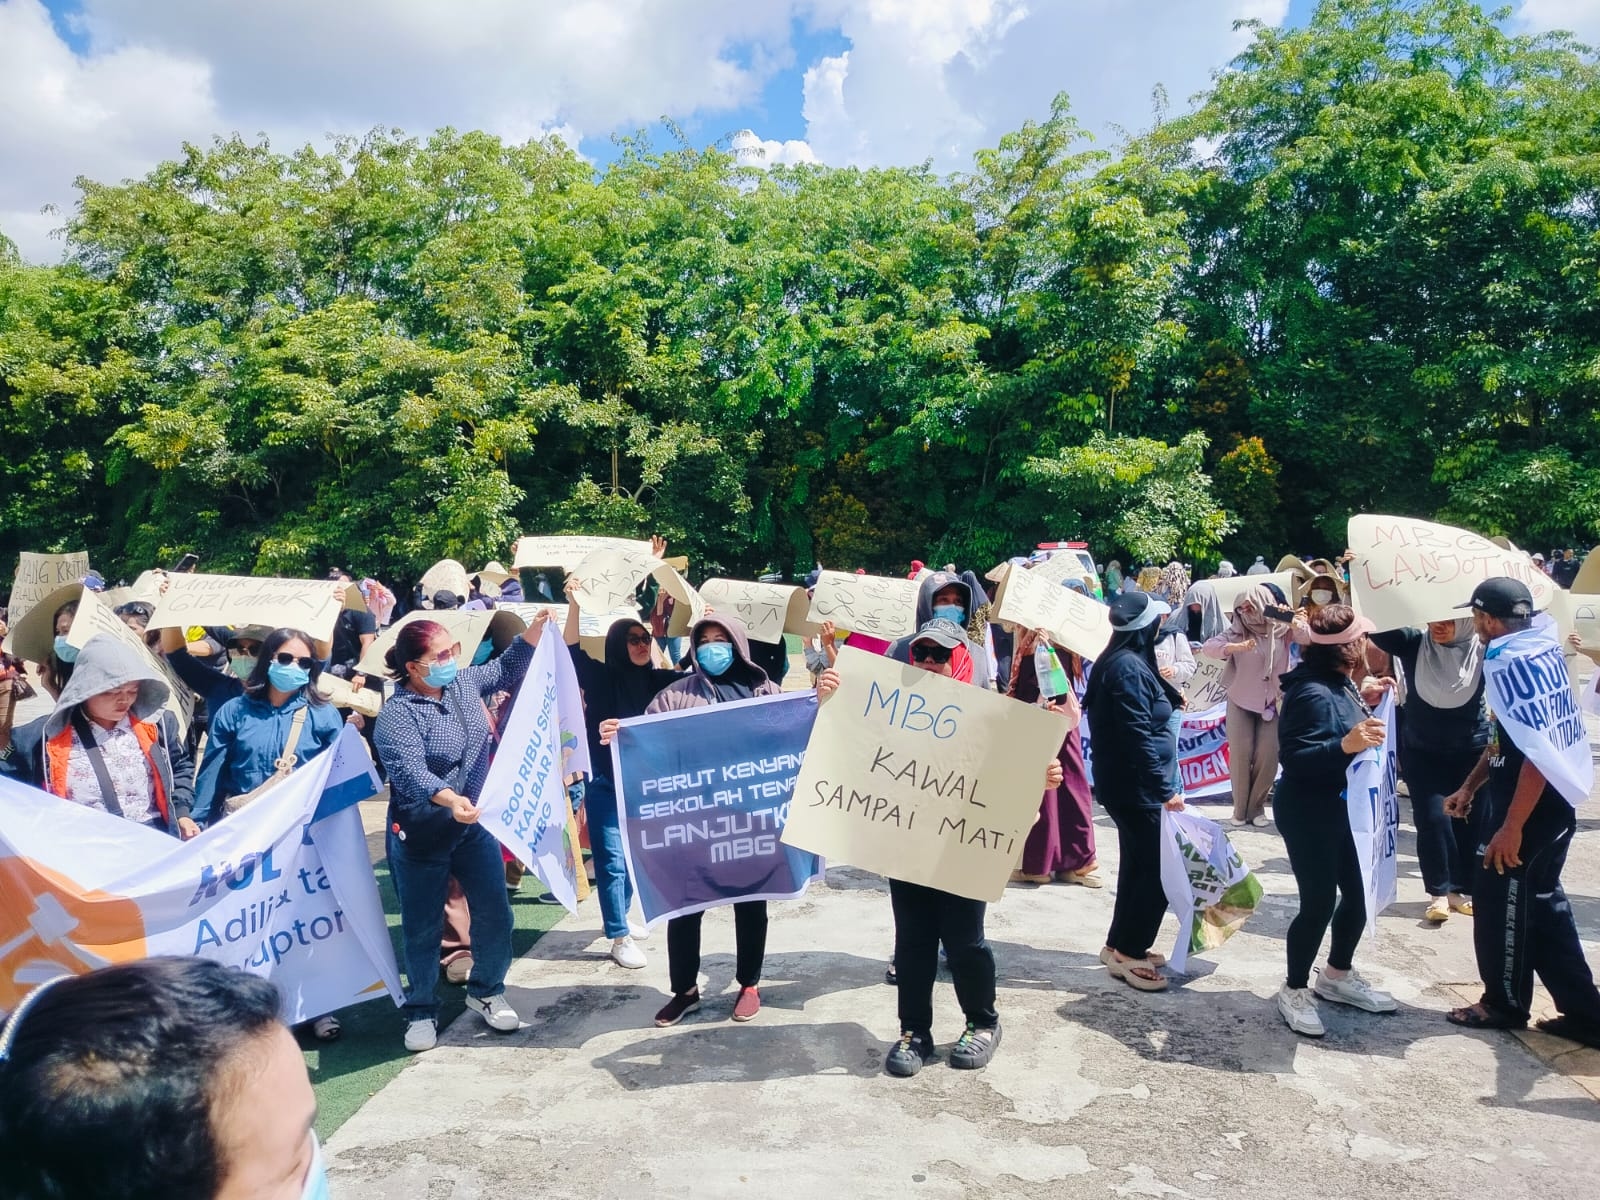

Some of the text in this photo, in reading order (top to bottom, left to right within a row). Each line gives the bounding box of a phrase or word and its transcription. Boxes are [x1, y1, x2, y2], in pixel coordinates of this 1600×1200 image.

[863, 680, 963, 739] MBG
[500, 782, 525, 827] 800
[518, 729, 542, 783] RIBU
[513, 754, 552, 841] KALBAR
[642, 769, 715, 796] PERUT
[869, 746, 987, 808] KAWAL
[527, 801, 552, 854] MBG
[639, 788, 742, 821] SEKOLAH
[640, 802, 791, 850] LANJUTK
[710, 834, 776, 864] MBG
